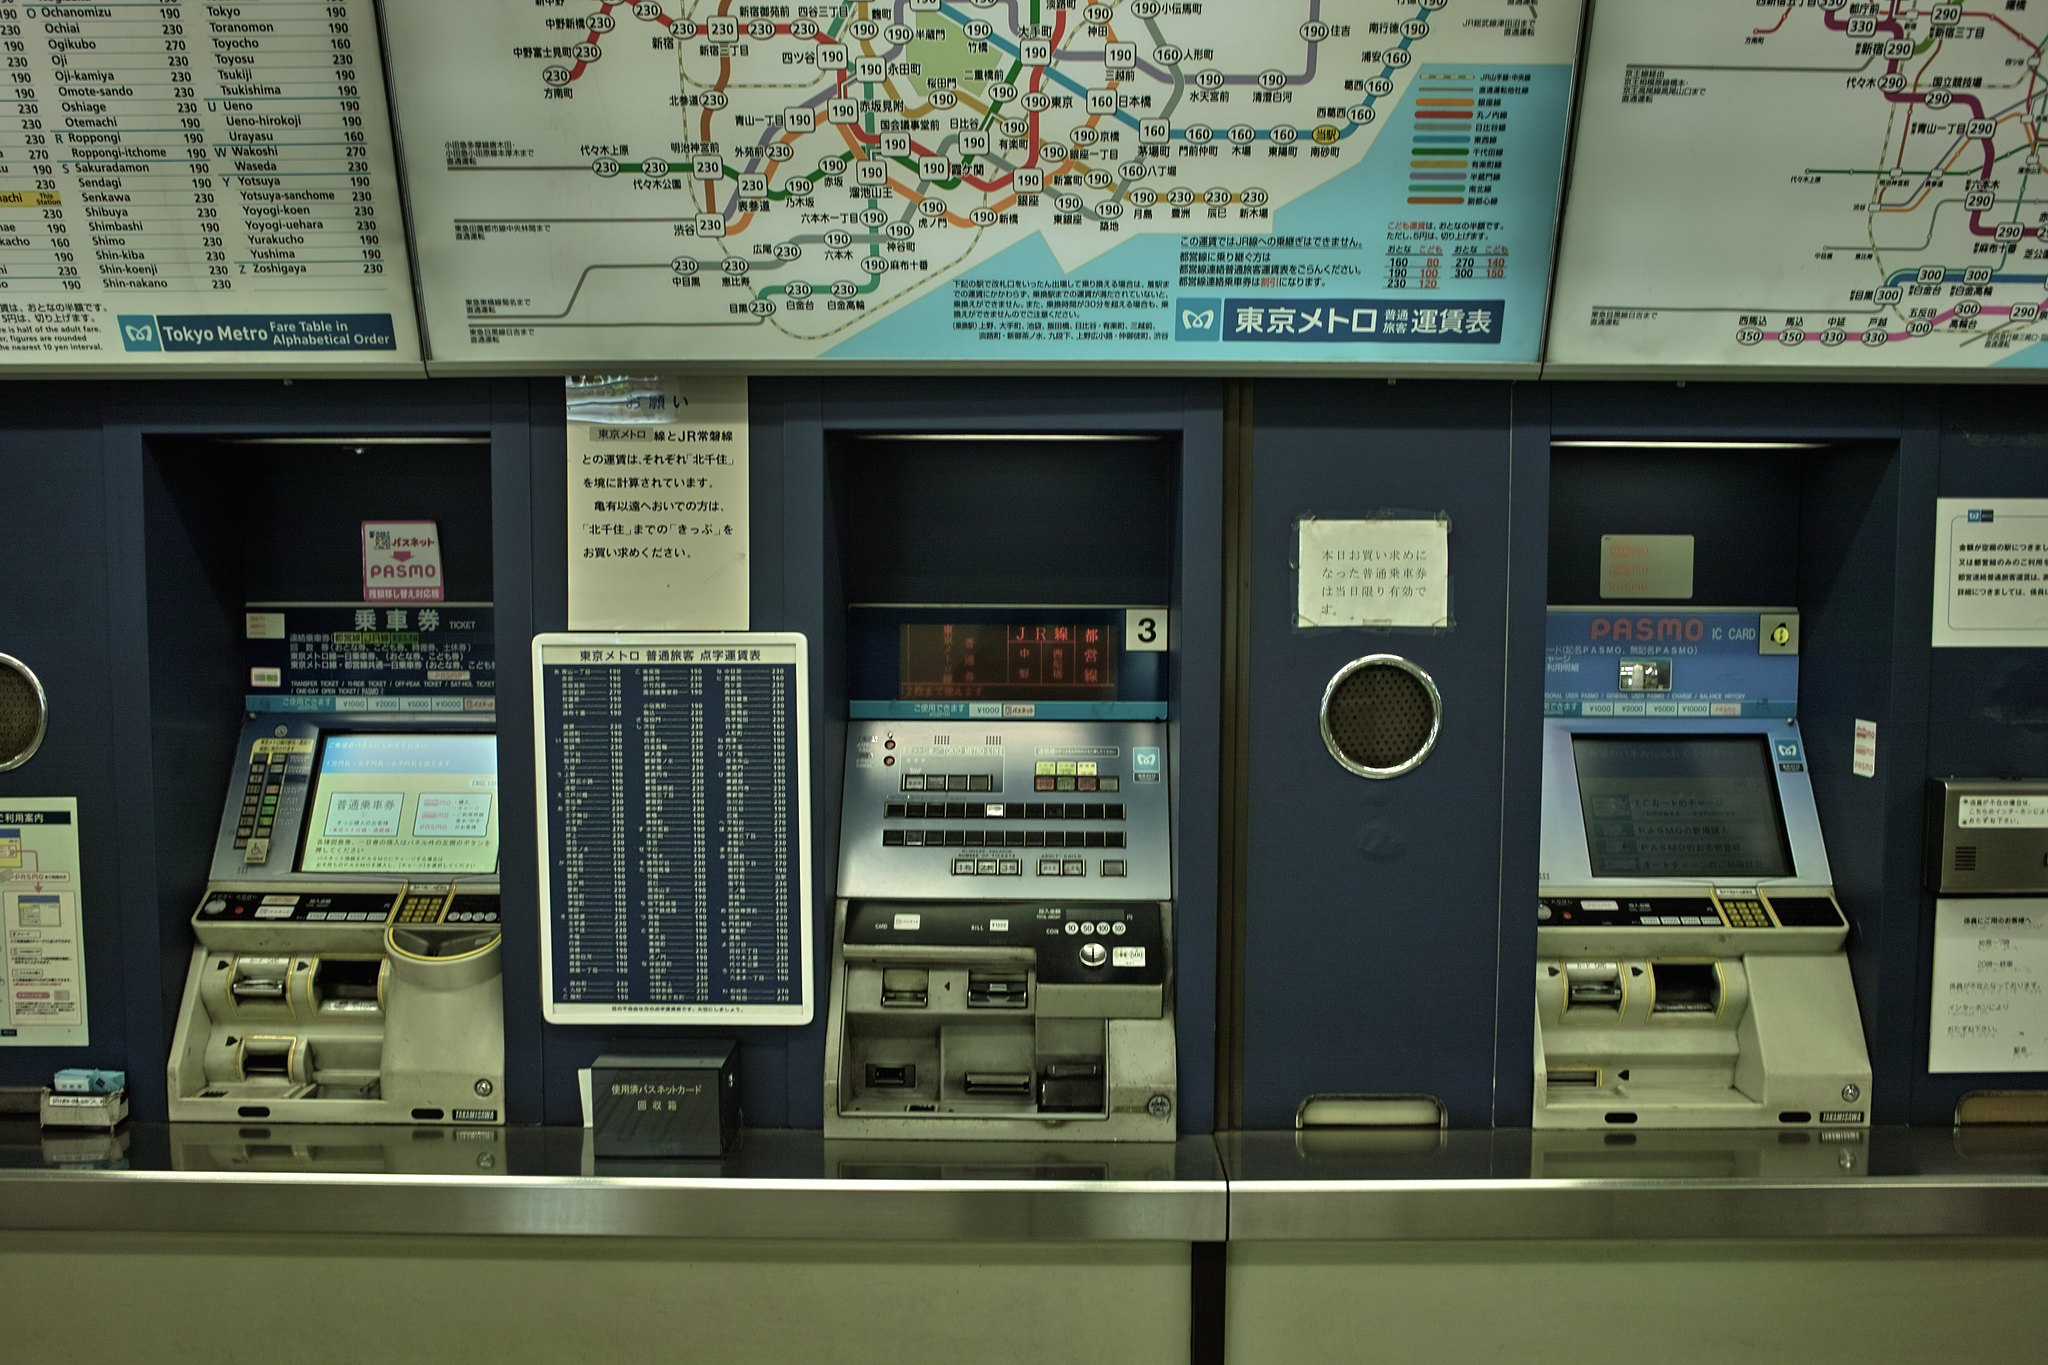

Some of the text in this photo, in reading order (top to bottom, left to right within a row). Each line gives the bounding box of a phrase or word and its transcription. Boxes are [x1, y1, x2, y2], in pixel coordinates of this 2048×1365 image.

[27, 5, 179, 18] O Ochanomizu 190
[207, 6, 346, 18] Tokyo 190
[546, 18, 610, 30] 中野新橋 230
[1850, 21, 1873, 33] 330
[1019, 26, 1052, 38] 大手町
[48, 39, 185, 52] Ogikubo 270
[212, 38, 350, 50] Toyocho 160
[652, 37, 674, 49] 新宿
[513, 47, 598, 59] 中野富士見町 230
[700, 45, 749, 56] 新宿三丁目
[1183, 49, 1213, 61] 人形町
[1361, 52, 1407, 64] 浦安 160
[965, 70, 1003, 81] 二重橋前
[1846, 77, 1903, 89] 代々木 290
[1932, 78, 1982, 89] 国立競技場
[59, 86, 194, 97] Omote-sando 230
[544, 88, 573, 99] 方南町
[208, 101, 359, 112] U Ueno 190
[702, 95, 725, 106] 230
[860, 100, 904, 112] 赤坂見附
[1050, 96, 1073, 108] 東京
[1091, 96, 1152, 108] 160 日本橋
[1317, 107, 1346, 118] 西葛西
[880, 119, 940, 131] 国会議事堂前
[55, 131, 203, 144] R Roppongi 190
[1316, 129, 1337, 141] 当駅
[999, 138, 1028, 150] 有楽町
[232, 145, 366, 156] Wakoshi 270
[580, 145, 629, 156] 代々木上原
[1070, 150, 1119, 161] 銀座一丁目
[1178, 146, 1218, 157] 門前仲町
[1310, 146, 1340, 157] 南砂町
[75, 161, 209, 173] Sakuradamon 190
[633, 179, 682, 190] 代々木公園
[240, 190, 371, 202] Yotsuya-sanchome 230
[1017, 194, 1039, 207] 銀座
[86, 207, 216, 218] Shibuya 230
[738, 201, 770, 212] 表参道
[1239, 208, 1268, 219] 新木場
[674, 220, 721, 236] 渋谷 230
[248, 234, 378, 244] Yurakucho 190
[254, 262, 382, 274] Zoshigaya 230
[1390, 258, 1440, 268] 160 80
[1455, 258, 1505, 268] 270 140
[270, 321, 347, 331] Fare Table in
[1235, 307, 1492, 334] 東京メトロ 普通 運賃表
[1739, 316, 1888, 328] 西馬込 馬込 中延 戸越
[1383, 322, 1407, 334] 旅客
[162, 326, 267, 344] Tokyo Metro
[274, 334, 388, 347] Alphabetical Order
[1740, 332, 1843, 342] 350 330
[626, 395, 688, 410] お願い
[598, 429, 646, 440] 東京メトロ
[583, 477, 713, 489] を境に計算されています。
[594, 501, 725, 512] 亀有以遠へおいでの方は、
[391, 538, 435, 548] パスネット
[583, 548, 691, 559] お買い求めください。
[1322, 550, 1427, 561] 本日お買い求めに
[370, 565, 436, 578] PASMO
[1322, 567, 1427, 579] なった普通乗車券
[1322, 586, 1427, 598] は当日限り有効で
[1321, 604, 1337, 616] す。
[355, 609, 476, 631] 乗車券 TICKET
[1137, 618, 1157, 643] 3
[1590, 618, 1756, 642] PASMO IC CARD
[580, 650, 761, 662] 東京メトロ 普通旅客 点字運賃表
[337, 800, 395, 811] 普通乗車券
[611, 1084, 702, 1095] 使用済パスネットカード
[637, 1100, 677, 1111] 回収箱
